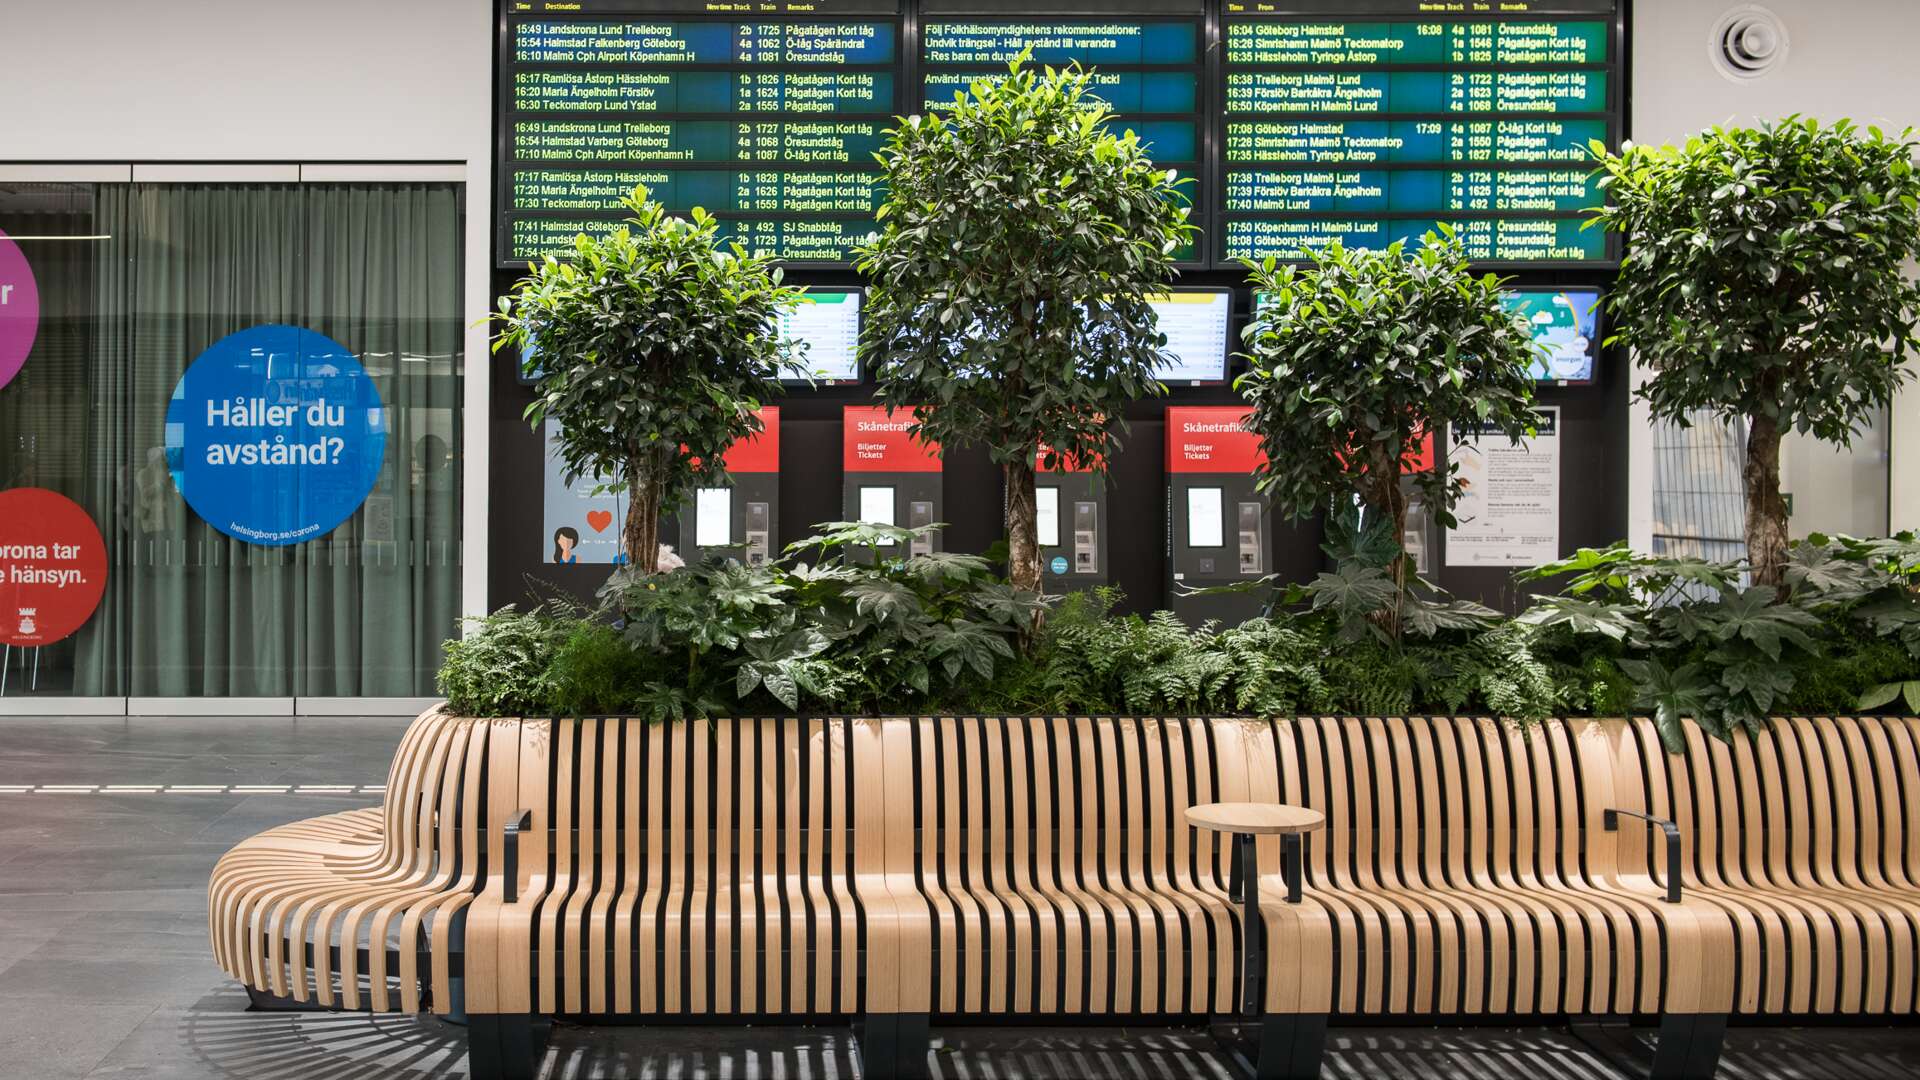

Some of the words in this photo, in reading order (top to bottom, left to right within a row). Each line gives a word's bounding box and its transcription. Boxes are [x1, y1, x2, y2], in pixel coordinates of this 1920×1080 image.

[516, 24, 542, 35] 15:49
[543, 24, 598, 35] Landskrona
[599, 24, 623, 35] Lund
[624, 24, 672, 37] Trelleborg
[739, 25, 753, 36] 2b
[757, 25, 781, 36] 1725
[785, 25, 836, 38] Pågatågen
[837, 25, 858, 36] Kort
[858, 25, 875, 38] tåg
[925, 24, 943, 37] Följ
[944, 24, 1052, 37] Folkhälsomyndighetens
[1053, 24, 1140, 35] rekommendationer:
[1255, 25, 1299, 38] Göteborg
[1300, 25, 1345, 36] Halmstad
[1498, 22, 1558, 37] Öresundståg
[516, 37, 542, 48] 15:54
[543, 37, 587, 48] Halmstad
[588, 37, 641, 50] Falkenberg
[642, 37, 686, 50] Göteborg
[738, 38, 753, 49] 4a
[757, 38, 781, 49] 1062
[785, 36, 812, 51] Ö-tåg
[813, 38, 865, 51] Spårändrat
[924, 38, 958, 49] Undvik
[958, 38, 996, 51] trängsel
[1003, 38, 1023, 49] Håll
[1062, 38, 1074, 49] till
[1074, 38, 1117, 49] varandra
[516, 50, 542, 61] 16:10
[543, 50, 575, 61] Malmö
[576, 50, 596, 63] Cph
[597, 50, 628, 63] Airport
[629, 50, 685, 63] Köpenhamn
[686, 50, 695, 61] H
[739, 51, 752, 62] 4a
[758, 51, 779, 62] 1081
[785, 49, 845, 64] Öresundståg
[930, 51, 950, 62] Res
[951, 51, 973, 62] bara
[974, 51, 990, 62] om
[991, 51, 1005, 62] du
[1005, 50, 1036, 61] måe.
[516, 73, 540, 84] 16:17
[542, 73, 583, 84] Ramlösa
[584, 71, 614, 86] Åstorp
[616, 73, 670, 84] Hässleholm
[740, 74, 751, 85] 1b
[757, 74, 779, 85] 1826
[785, 74, 834, 87] Pågatågen
[836, 74, 856, 85] Kort
[858, 74, 873, 87] tåg
[924, 73, 959, 84] Använd
[1255, 74, 1303, 87] Trelleborg
[1304, 74, 1335, 85] Malmö
[1336, 74, 1361, 85] Lund
[1497, 73, 1548, 86] Pågatågen
[1548, 73, 1569, 84] Kort
[1570, 73, 1586, 86] tåg
[515, 86, 541, 97] 16:20
[542, 86, 569, 97] Maria
[570, 84, 618, 99] Ängelholm
[619, 86, 655, 97] Förslöv
[740, 87, 751, 98] 1a
[756, 87, 778, 98] 1624
[785, 87, 834, 100] Pågatågen
[836, 87, 856, 98] Kort
[857, 87, 873, 100] tåg
[515, 100, 540, 110] 16:30
[542, 100, 602, 112] Teckomatorp
[604, 100, 628, 110] Lund
[630, 100, 657, 110] Ystad
[738, 101, 751, 111] 2a
[756, 101, 779, 111] 1555
[784, 101, 834, 113] Pågatågen
[1073, 99, 1115, 112] rowding.
[1254, 101, 1310, 113] Köpenhamn
[1311, 101, 1320, 111] H
[1321, 101, 1353, 111] Malmö
[1354, 101, 1378, 111] Lund
[1497, 98, 1556, 112] Öresundståg
[514, 122, 540, 133] 16:49
[541, 122, 596, 133] Landskrona
[597, 122, 622, 133] Lund
[623, 122, 671, 135] Trelleborg
[738, 123, 751, 134] 2b
[756, 123, 779, 134] 1727
[784, 123, 834, 136] Pågatågen
[836, 123, 856, 134] Kort
[857, 123, 873, 136] tåg
[514, 135, 540, 146] 16:54
[541, 135, 586, 146] Halmstad
[586, 135, 624, 148] Varberg
[625, 135, 669, 148] Göteborg
[737, 136, 751, 147] 4a
[756, 136, 779, 147] 1068
[784, 134, 844, 149] Öresundståg
[514, 149, 540, 159] 17:10
[541, 149, 573, 159] Malmö
[574, 149, 594, 161] Cph
[595, 149, 627, 161] Airport
[628, 149, 684, 161] Köpenhamn
[685, 149, 694, 159] H
[737, 150, 751, 160] 4a
[756, 150, 778, 160] 1087
[784, 148, 810, 162] Ö-tåg
[812, 150, 831, 160] Kort
[833, 150, 849, 162] tåg
[1253, 199, 1285, 210] Malmö
[1286, 199, 1310, 210] Lund
[1496, 198, 1509, 209] SJ
[1510, 198, 1556, 211] Snabbtåg
[207, 397, 298, 427] Håller
[306, 399, 345, 427] du
[1183, 422, 1252, 433] Skånetrafik
[206, 435, 344, 465] avstånd?
[857, 443, 887, 452] Biljetter
[1183, 444, 1213, 453] Biljetter
[857, 451, 883, 459] Tickets
[1184, 452, 1210, 460] Tickets
[230, 521, 320, 541] helsingborg.se/corona
[52, 543, 81, 559] tar
[11, 564, 87, 588] hänsyn.
